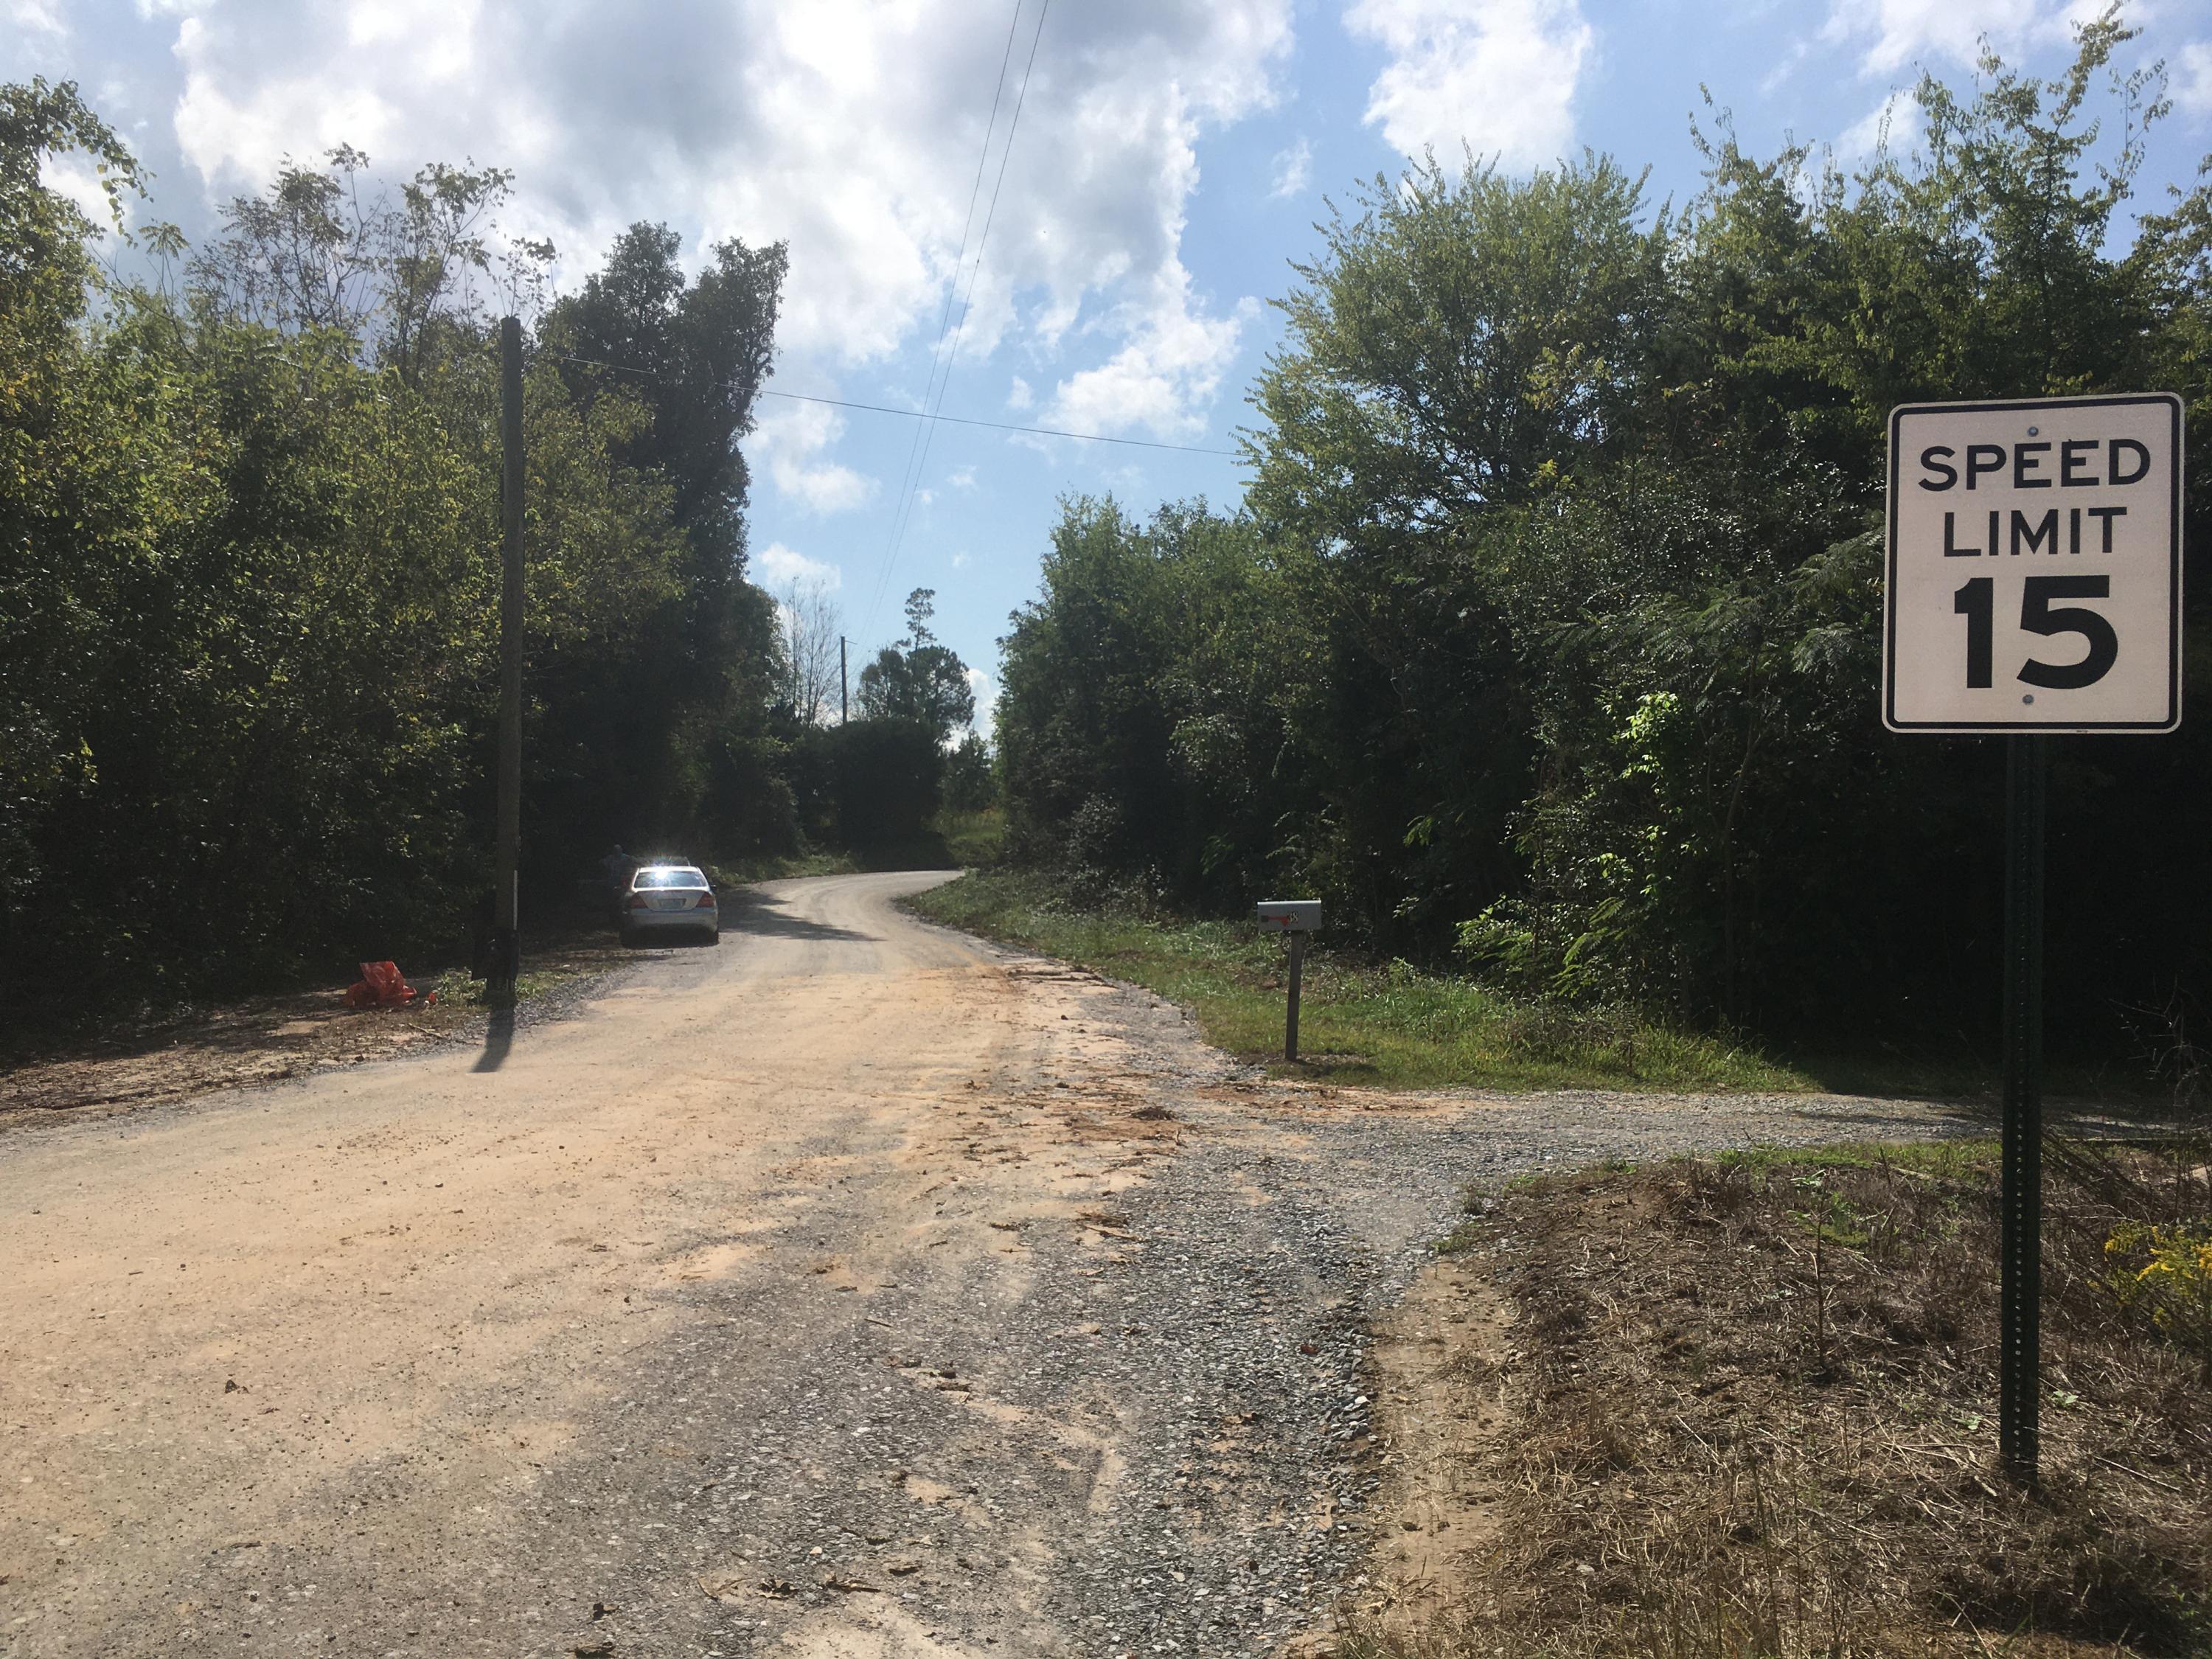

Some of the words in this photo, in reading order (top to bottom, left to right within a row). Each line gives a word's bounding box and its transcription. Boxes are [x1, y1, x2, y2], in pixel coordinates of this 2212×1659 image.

[1918, 438, 2151, 492] SPEED
[1944, 507, 2128, 557] LIMIT
[1954, 574, 2118, 689] 15
